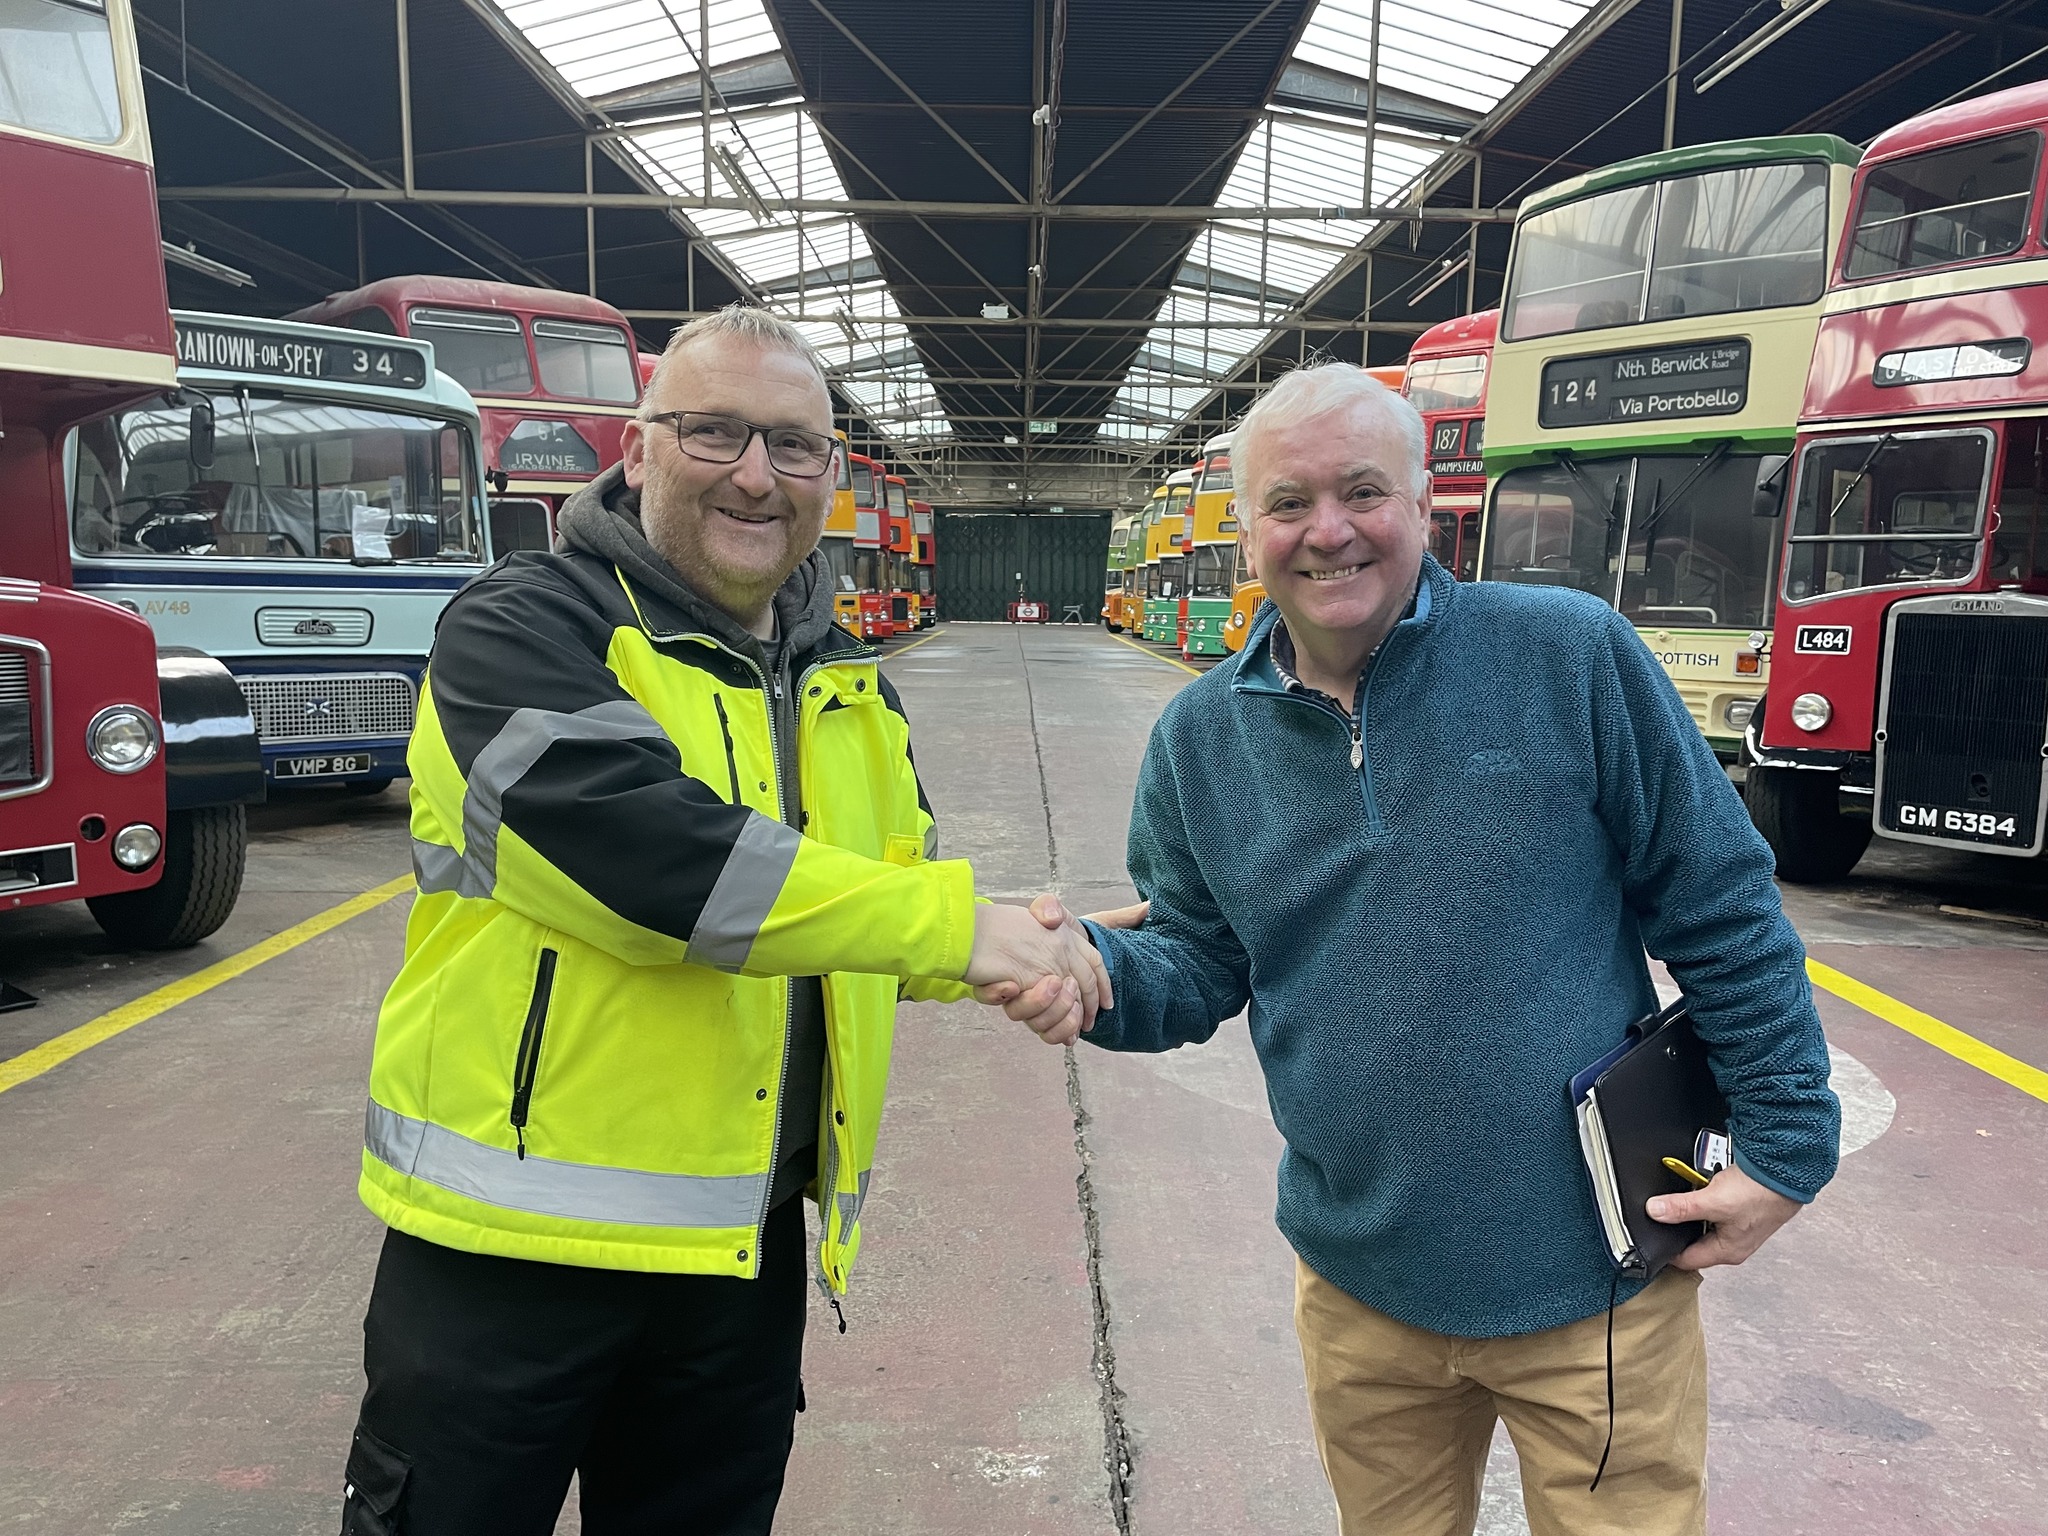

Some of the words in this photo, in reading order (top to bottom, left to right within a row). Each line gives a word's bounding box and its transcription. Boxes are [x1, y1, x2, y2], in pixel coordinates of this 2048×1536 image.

[175, 331, 323, 377] RANTOWN-ON-SPEY
[352, 350, 393, 376] 34
[1617, 360, 1647, 379] Nth.
[1651, 352, 1709, 375] Berwick
[1711, 360, 1729, 369] Road
[1551, 379, 1597, 405] 124
[1619, 398, 1643, 415] Via
[1648, 388, 1739, 413] Portobello
[1435, 428, 1460, 450] 187
[515, 453, 576, 467] IRVINE
[1435, 460, 1483, 473] HAMPSTEAD
[1951, 600, 2003, 612] LEYLAND
[1802, 631, 1845, 649] L484
[1653, 651, 1719, 667] COTTISH
[290, 761, 327, 775] VMP
[333, 757, 357, 771] 8G
[1900, 805, 1938, 828] GM
[1944, 810, 2016, 837] 6384
